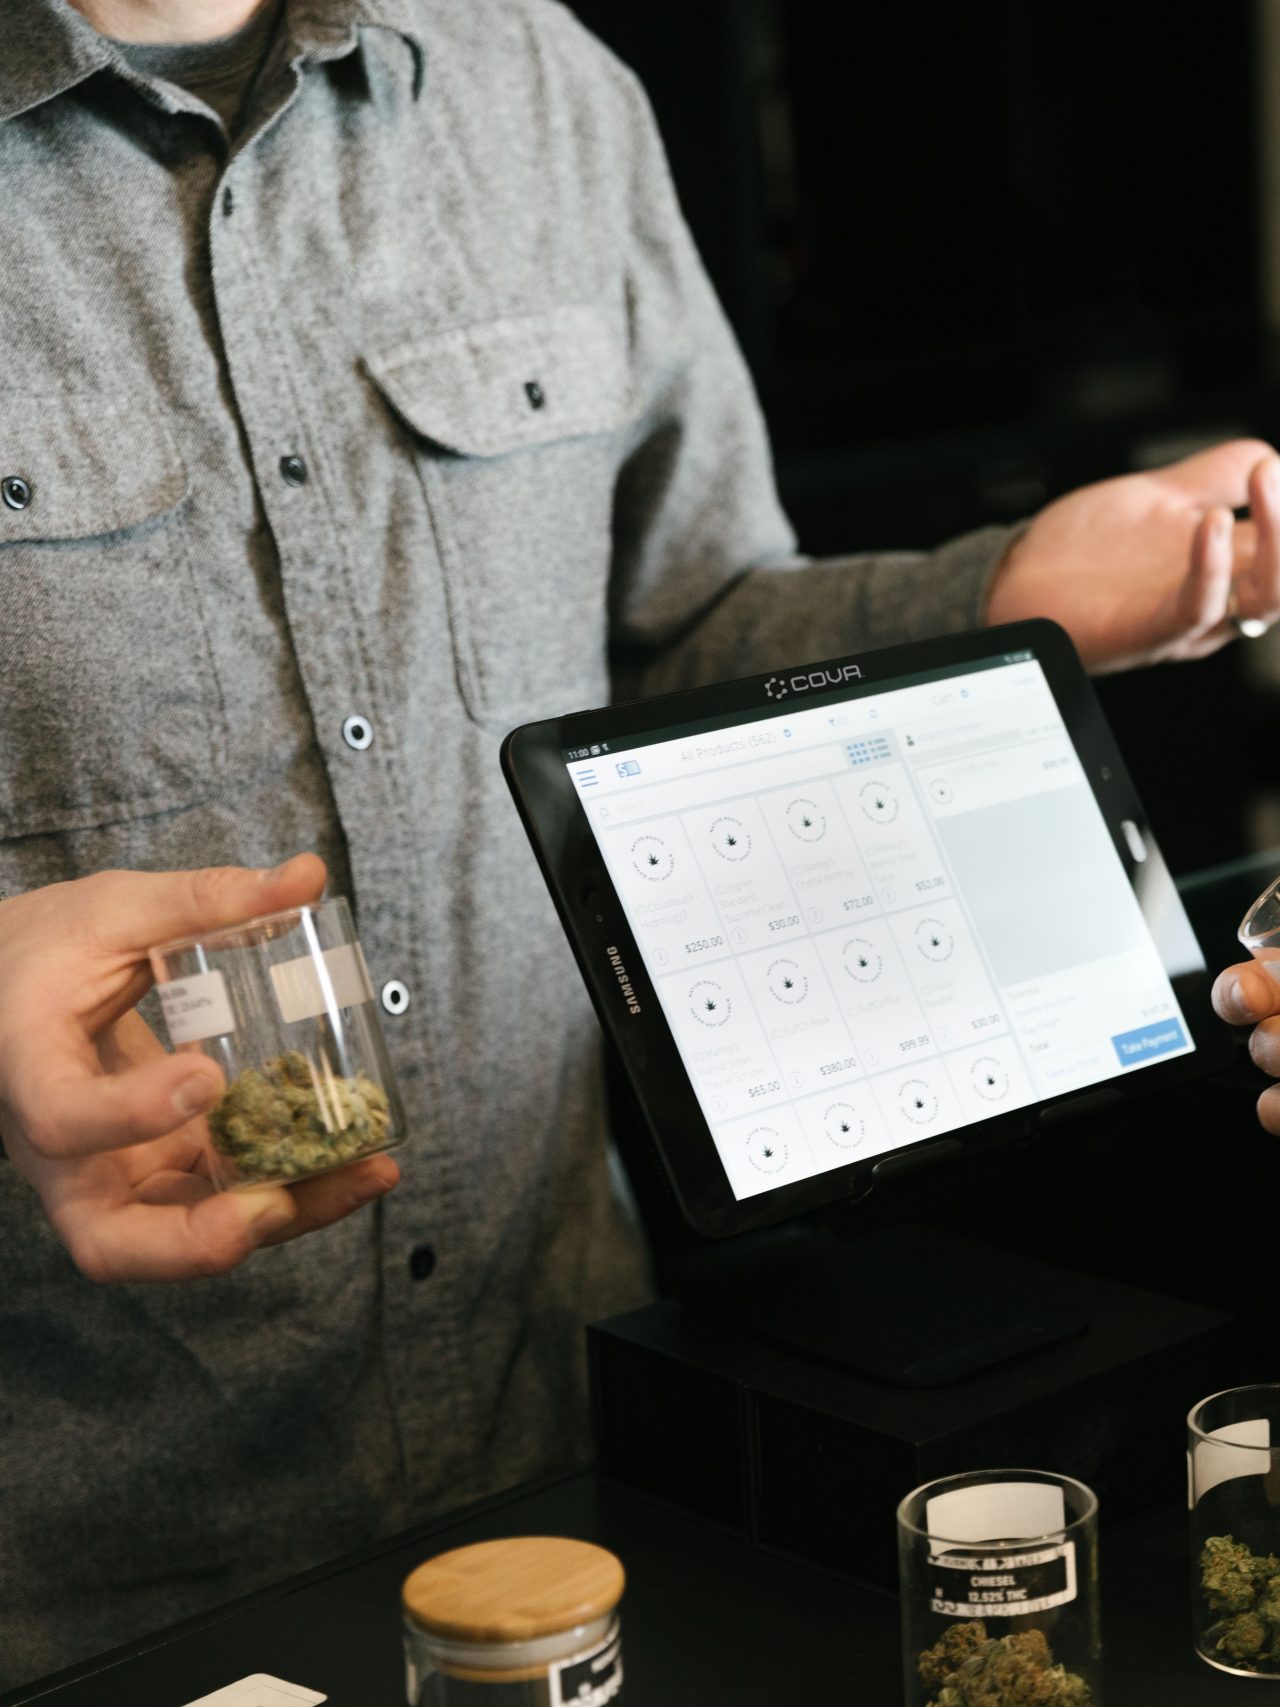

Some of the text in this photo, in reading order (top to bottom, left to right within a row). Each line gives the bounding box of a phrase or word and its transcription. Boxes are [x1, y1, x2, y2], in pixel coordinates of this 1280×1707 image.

[790, 664, 862, 692] COVA
[696, 740, 746, 759] Products
[915, 876, 945, 892] $52.00
[843, 895, 874, 911] $72.00
[768, 915, 799, 931] $30.00
[684, 935, 723, 954] $250.00
[607, 946, 641, 1014] SAMSUNG
[971, 1014, 1000, 1030] $30.00
[899, 1035, 930, 1052] $99.99
[1140, 1027, 1180, 1052] Payment
[819, 1057, 857, 1076] $380.00
[748, 1080, 781, 1098] $65.00
[1006, 1588, 1028, 1602] THC
